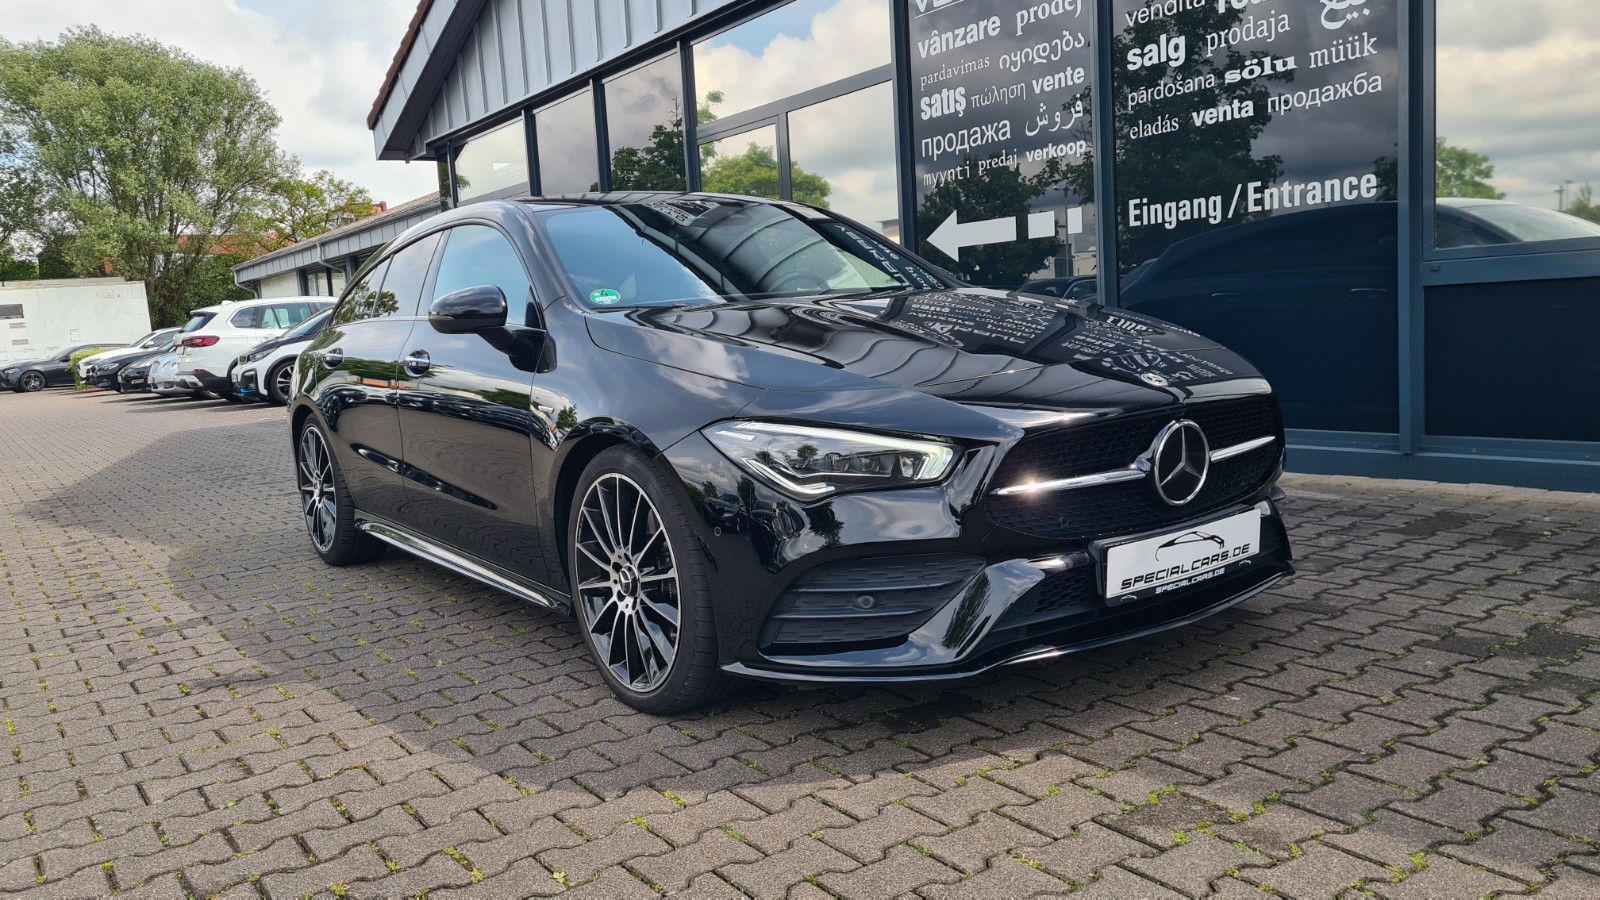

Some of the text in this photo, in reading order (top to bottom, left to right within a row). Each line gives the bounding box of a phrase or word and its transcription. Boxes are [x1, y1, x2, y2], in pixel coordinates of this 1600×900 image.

[917, 0, 1082, 59] vânzare prodej
[1127, 10, 1290, 71] salg prodaja
[920, 56, 991, 91] pardavimas
[1032, 67, 1085, 94] vente
[1127, 32, 1378, 111] pārdošana sölu müük
[920, 86, 967, 121] satış
[1267, 73, 1382, 116] продажба
[921, 119, 1012, 162] продажа
[1129, 99, 1254, 140] eladás venta
[923, 140, 1086, 188] myynti predaj verkoop
[1128, 196, 1222, 230] Eingang
[1247, 172, 1378, 213] Entrance
[1120, 543, 1251, 591] SPECIALCARS.DE
